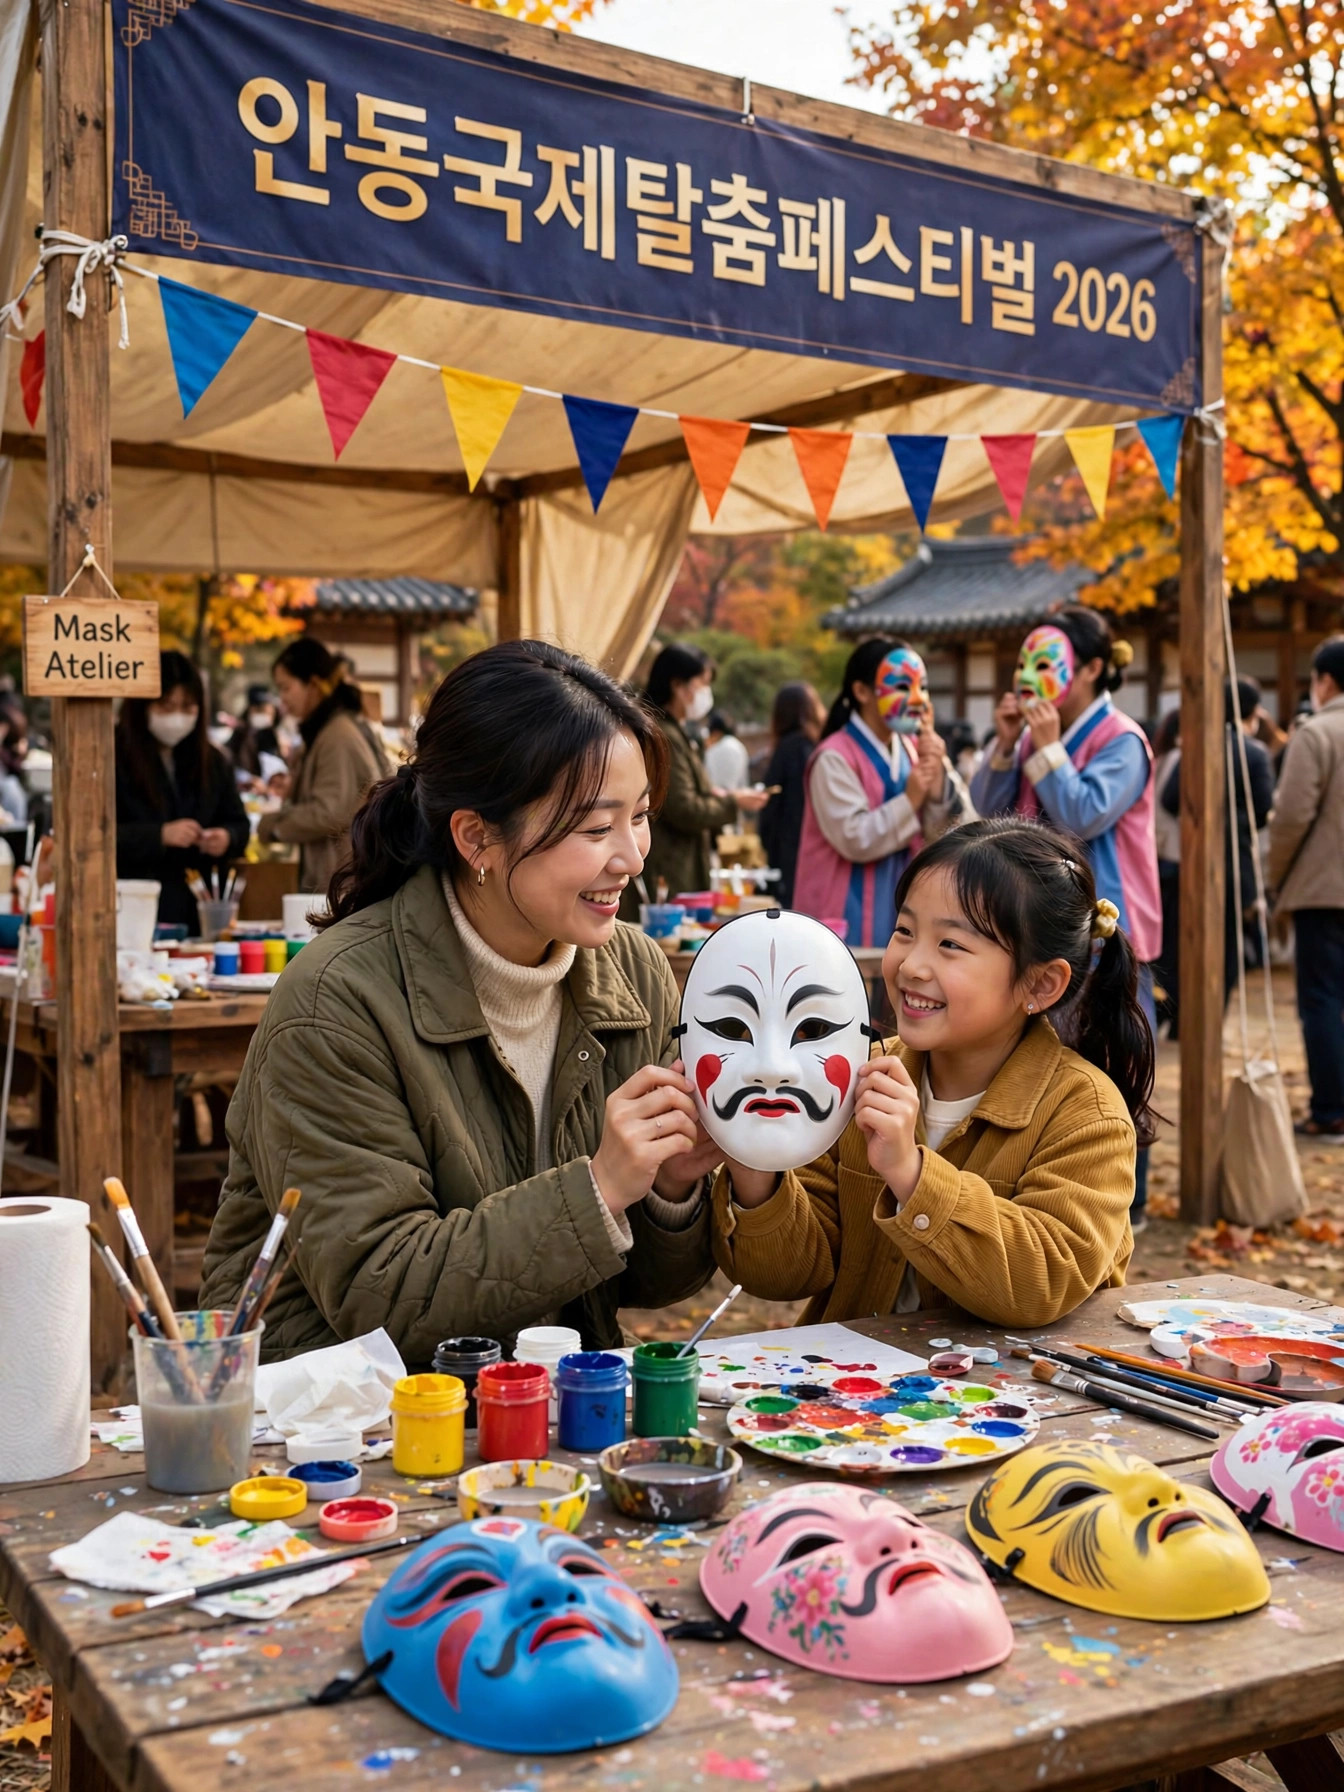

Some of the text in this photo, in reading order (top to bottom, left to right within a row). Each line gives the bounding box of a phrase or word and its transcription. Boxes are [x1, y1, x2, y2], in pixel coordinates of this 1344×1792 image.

[237, 76, 1157, 342] 안동국제탈춤페스티벌 2026
[54, 613, 131, 643] Mask
[45, 650, 144, 680] Atelier
